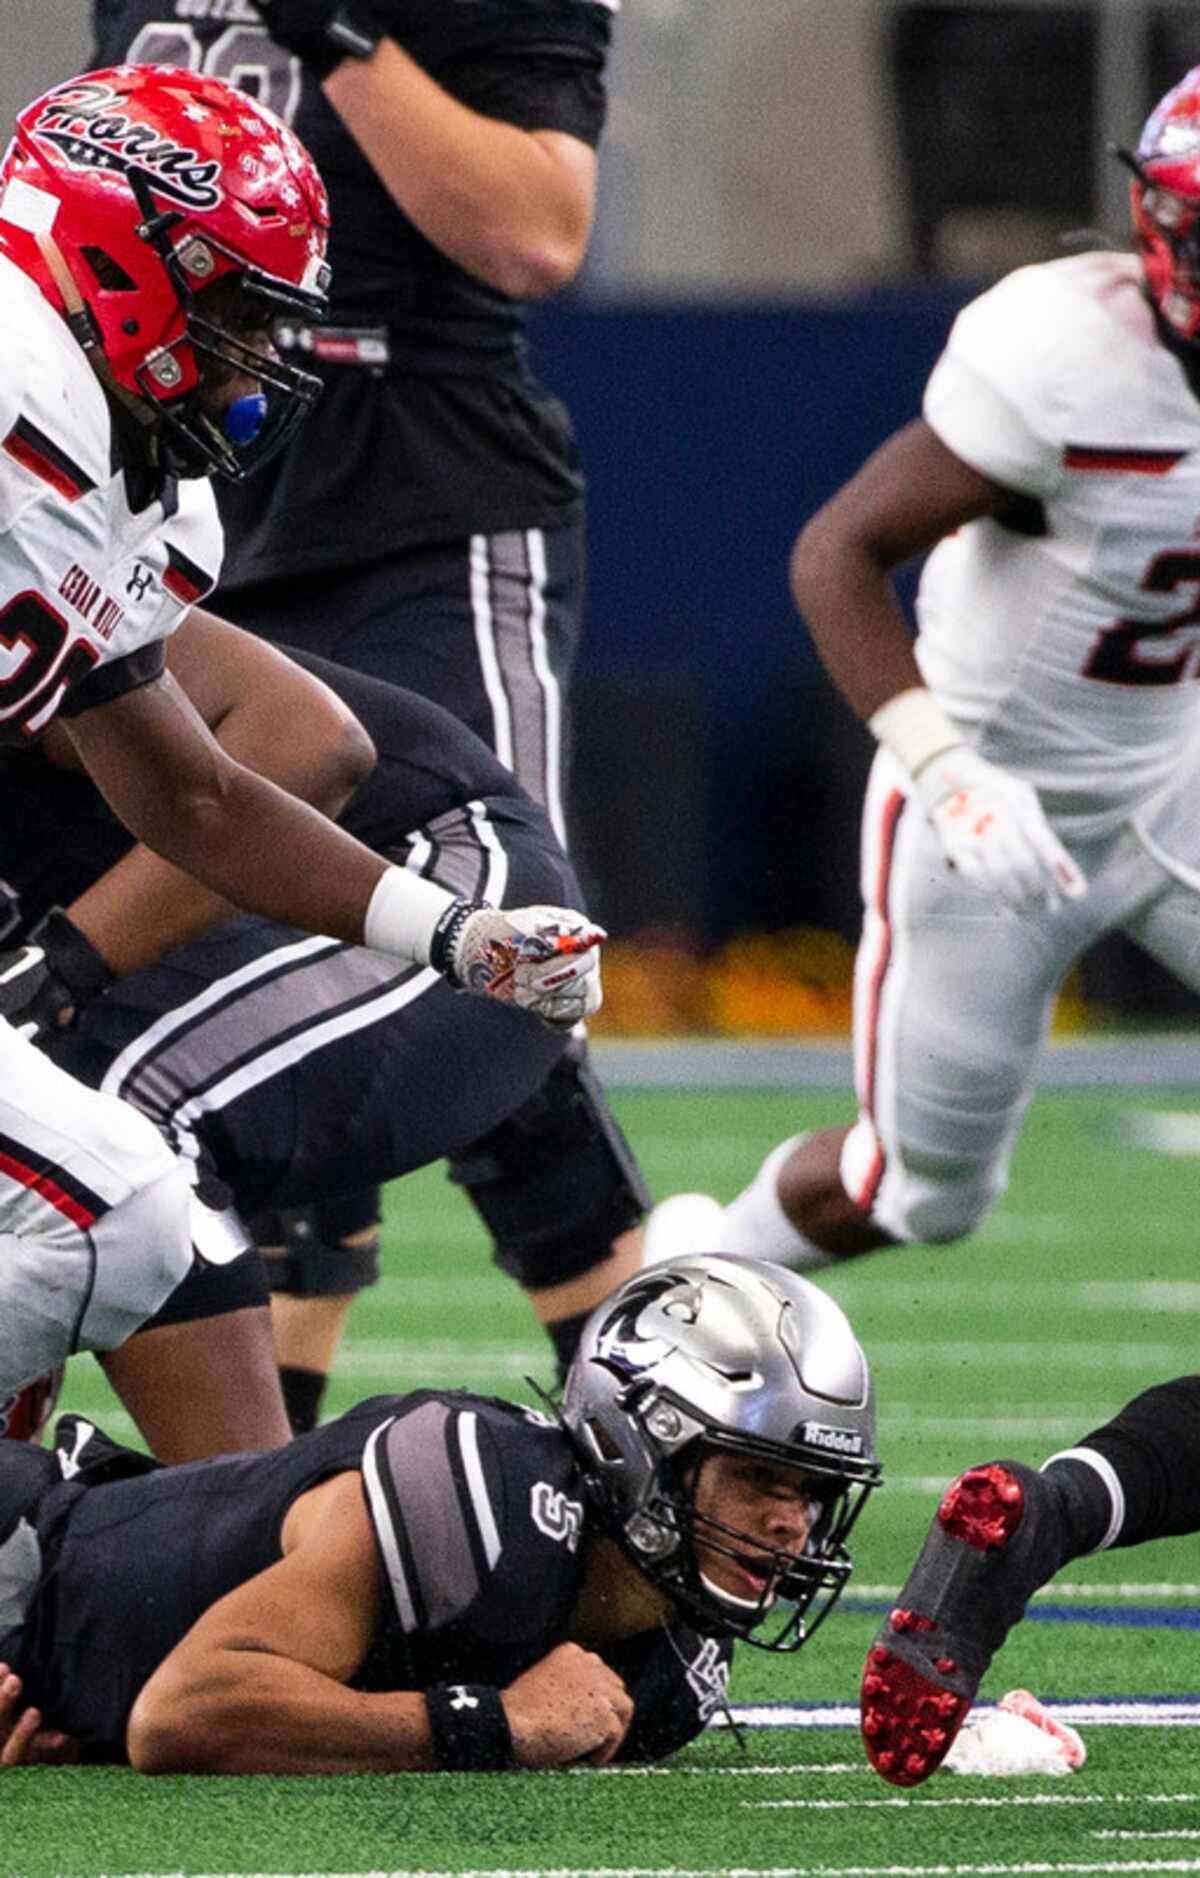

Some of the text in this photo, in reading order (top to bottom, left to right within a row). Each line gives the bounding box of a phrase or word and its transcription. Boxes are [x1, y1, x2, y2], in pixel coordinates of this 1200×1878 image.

[32, 83, 224, 208] Horns
[58, 563, 125, 641] CEDAR HILL
[804, 1421, 862, 1453] Riddell
